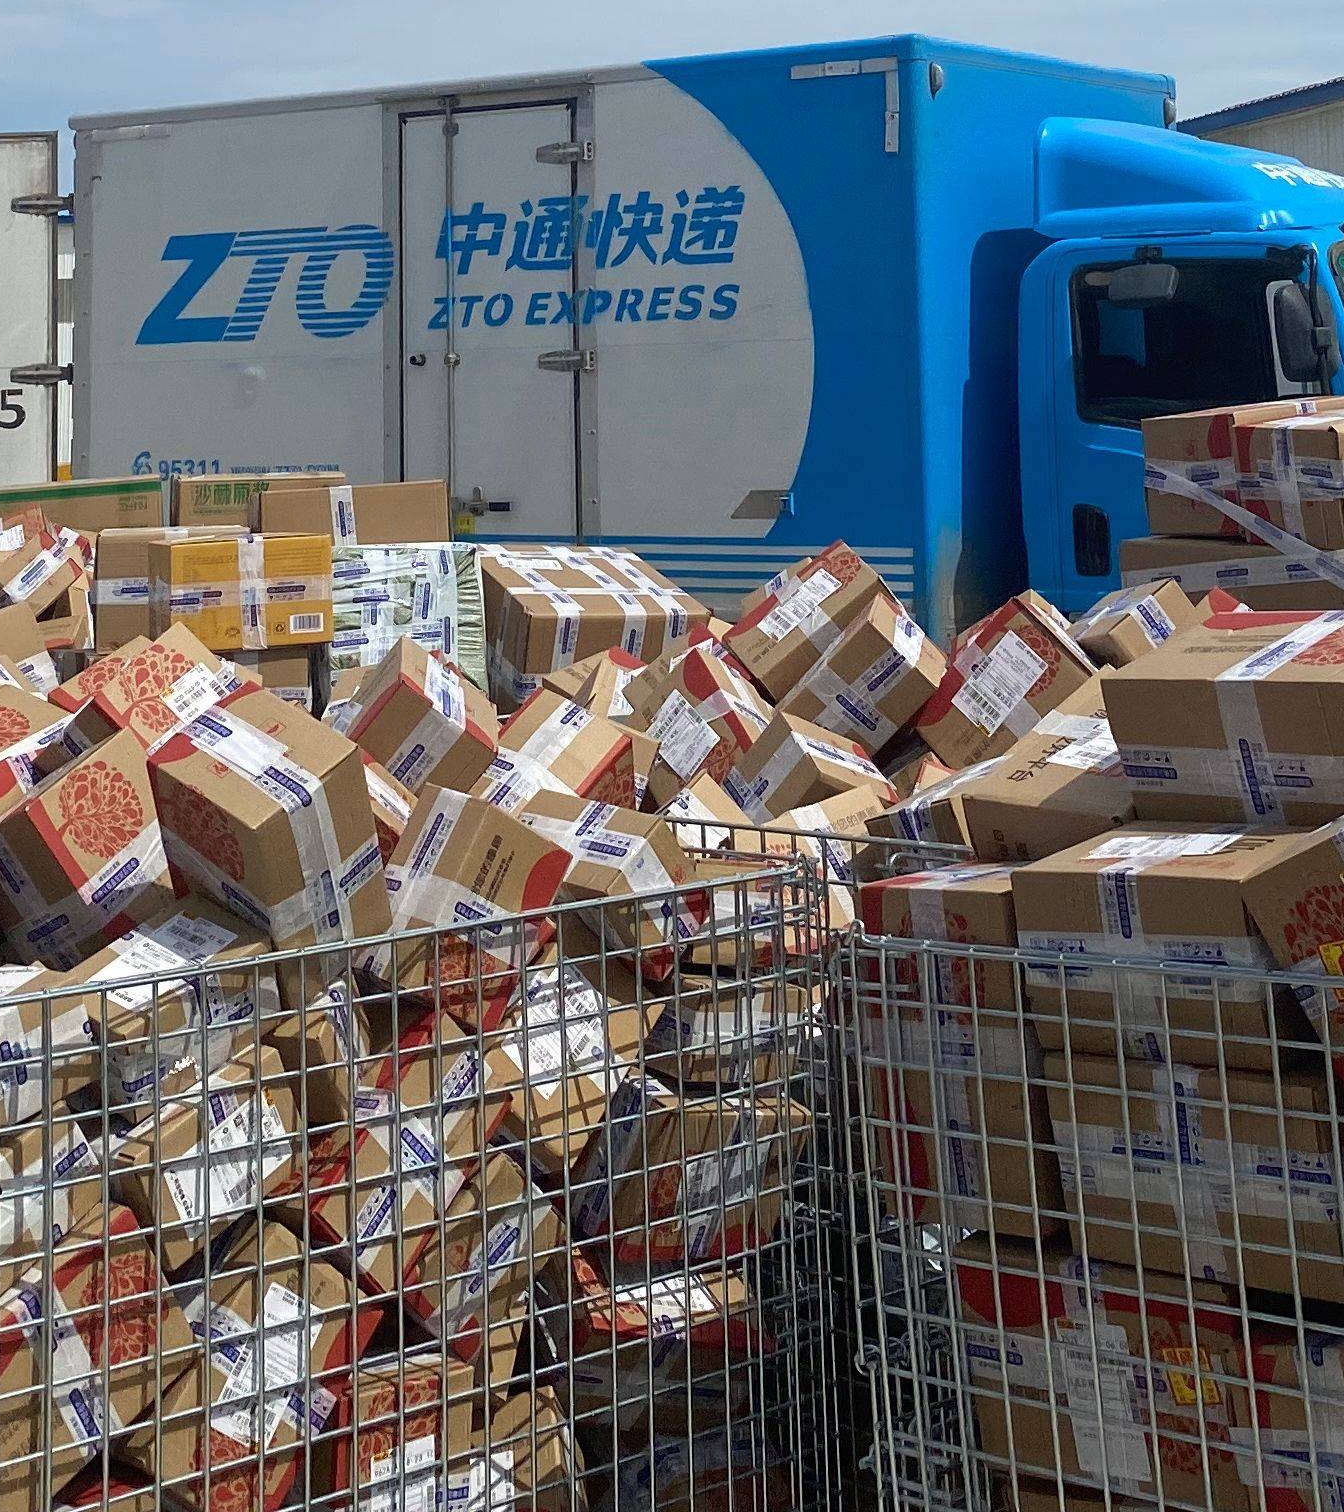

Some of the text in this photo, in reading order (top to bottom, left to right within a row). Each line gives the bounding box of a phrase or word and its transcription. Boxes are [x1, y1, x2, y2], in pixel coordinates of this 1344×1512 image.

[435, 185, 745, 275] 中通快递
[135, 224, 394, 345] ZTO
[428, 284, 740, 329] ZTO EXPRESS
